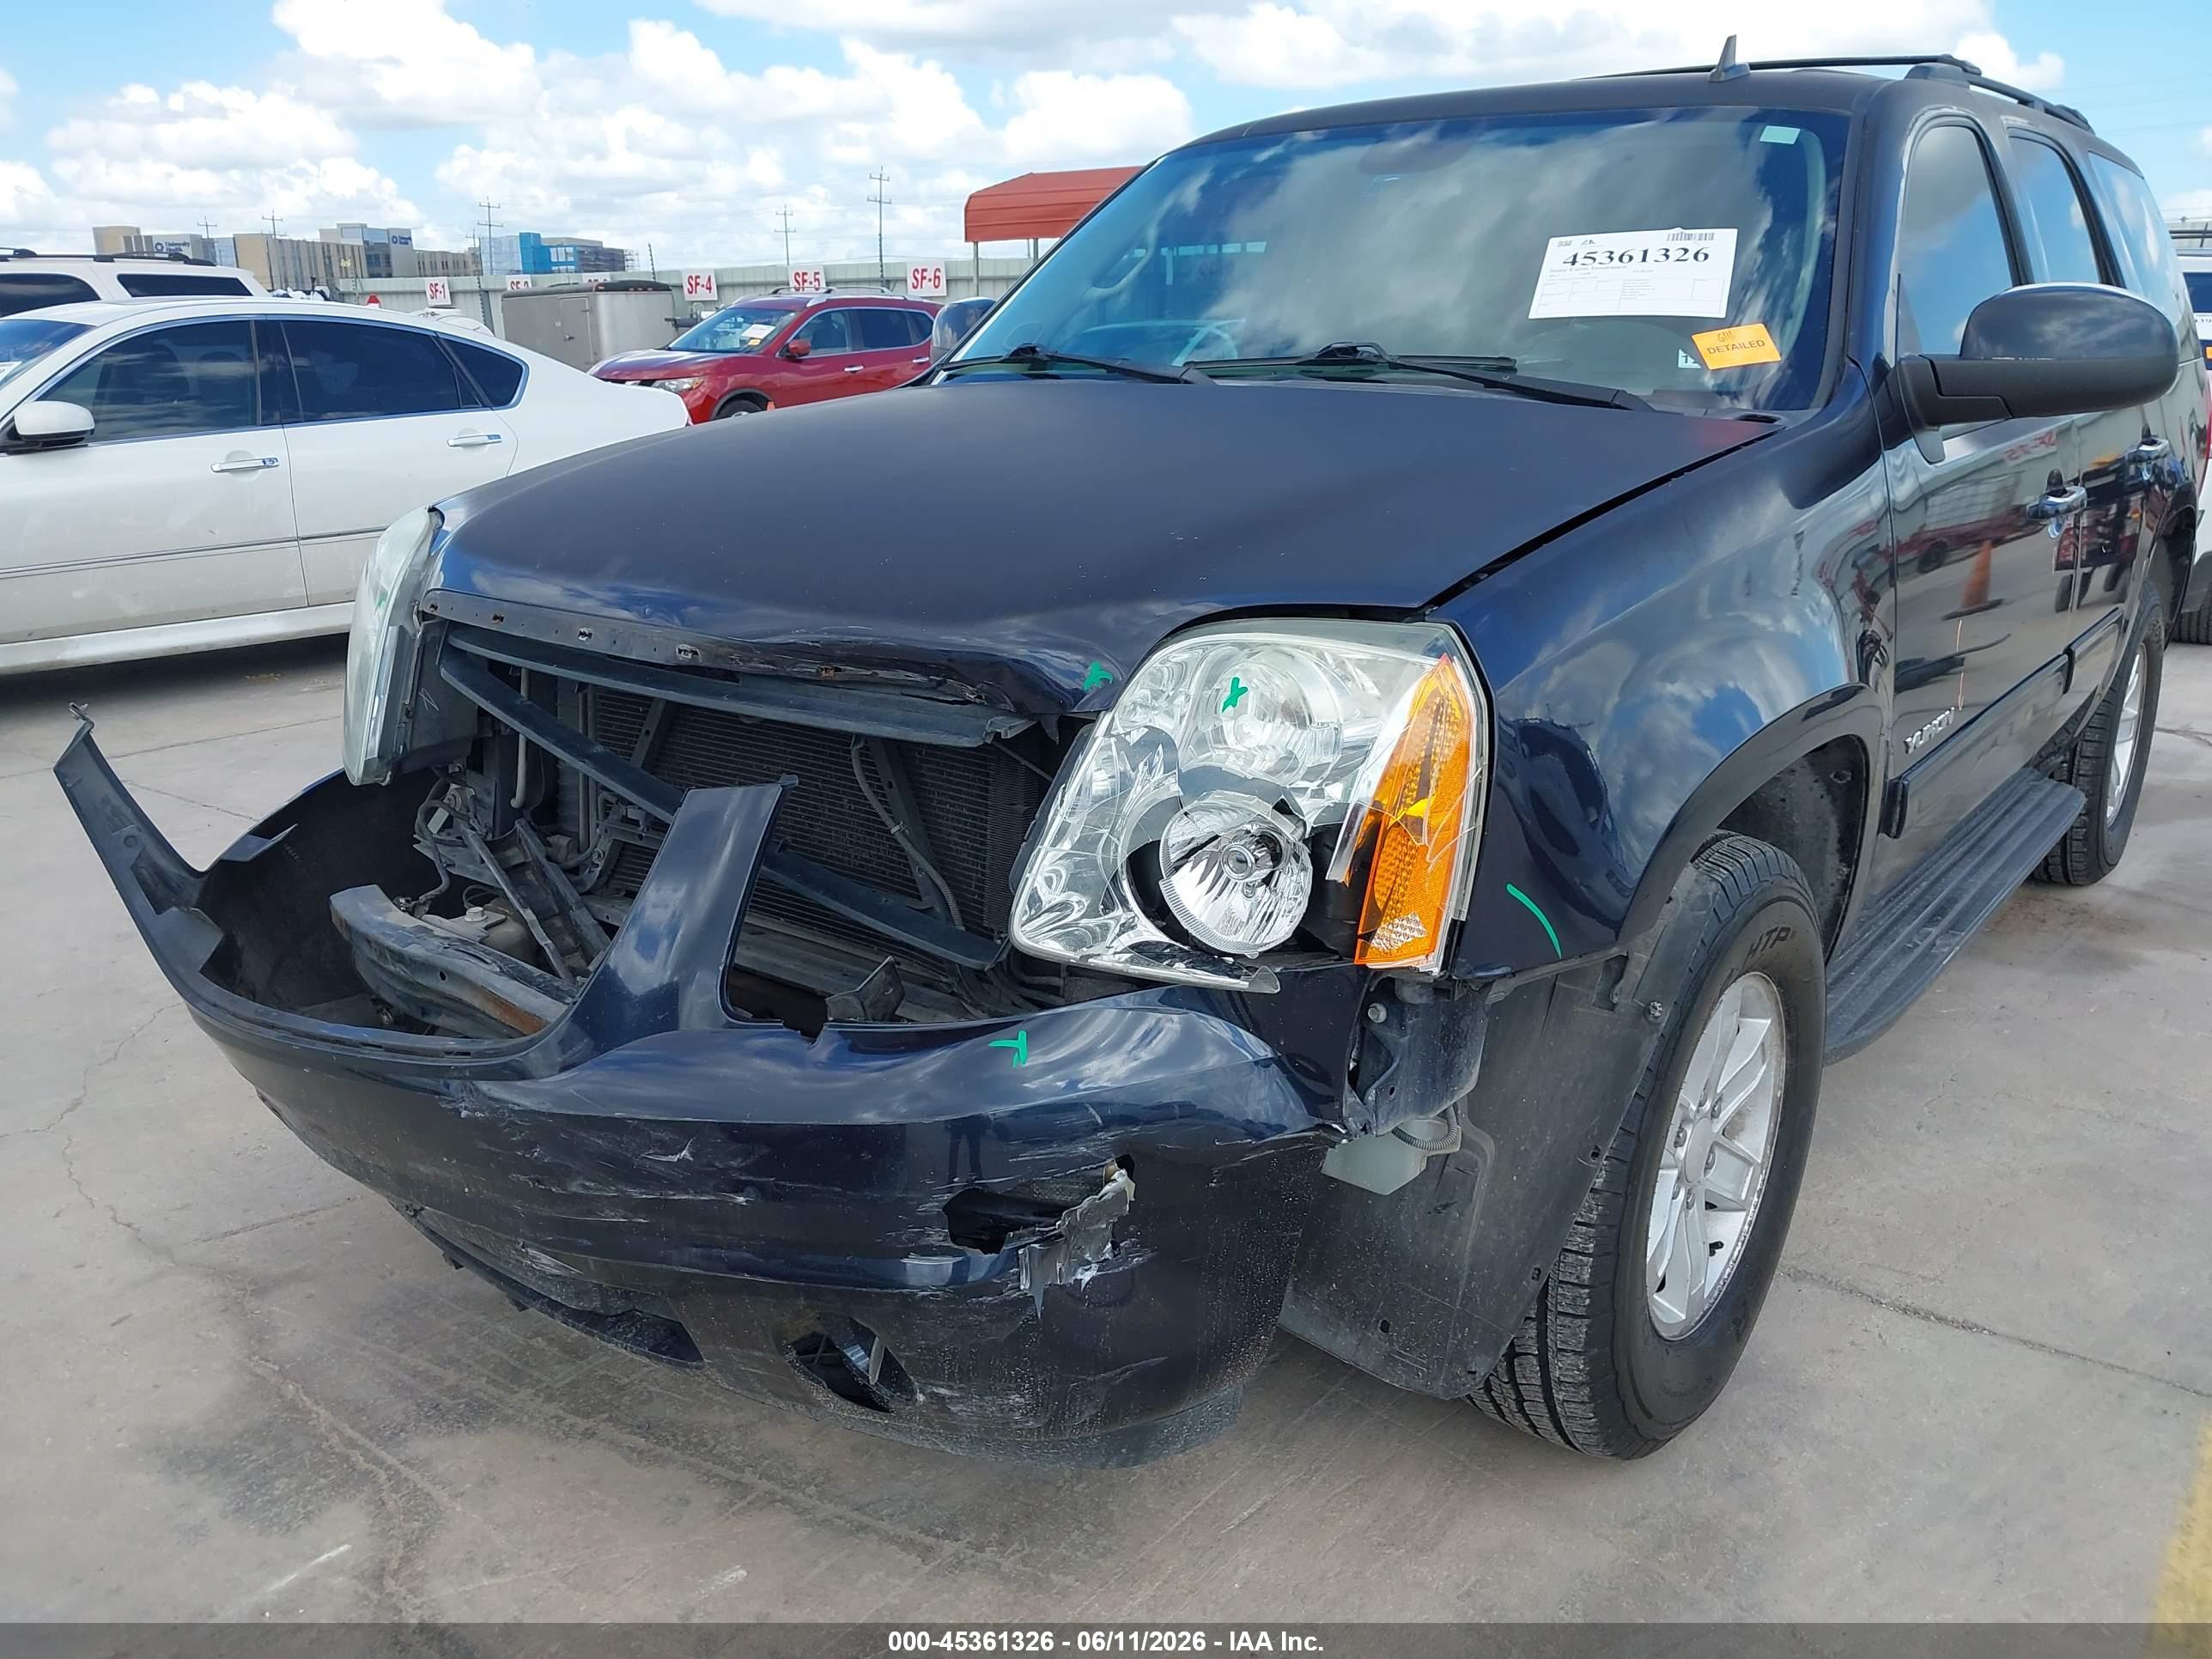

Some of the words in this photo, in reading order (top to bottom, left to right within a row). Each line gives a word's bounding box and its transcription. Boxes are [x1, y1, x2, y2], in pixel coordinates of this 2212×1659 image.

[1562, 246, 1711, 266] 45361326
[687, 274, 713, 295] SF-4
[793, 270, 821, 292] SF-5
[912, 268, 941, 289] SF-6
[429, 283, 447, 300] SF-1
[1707, 339, 1765, 355] DETAILED
